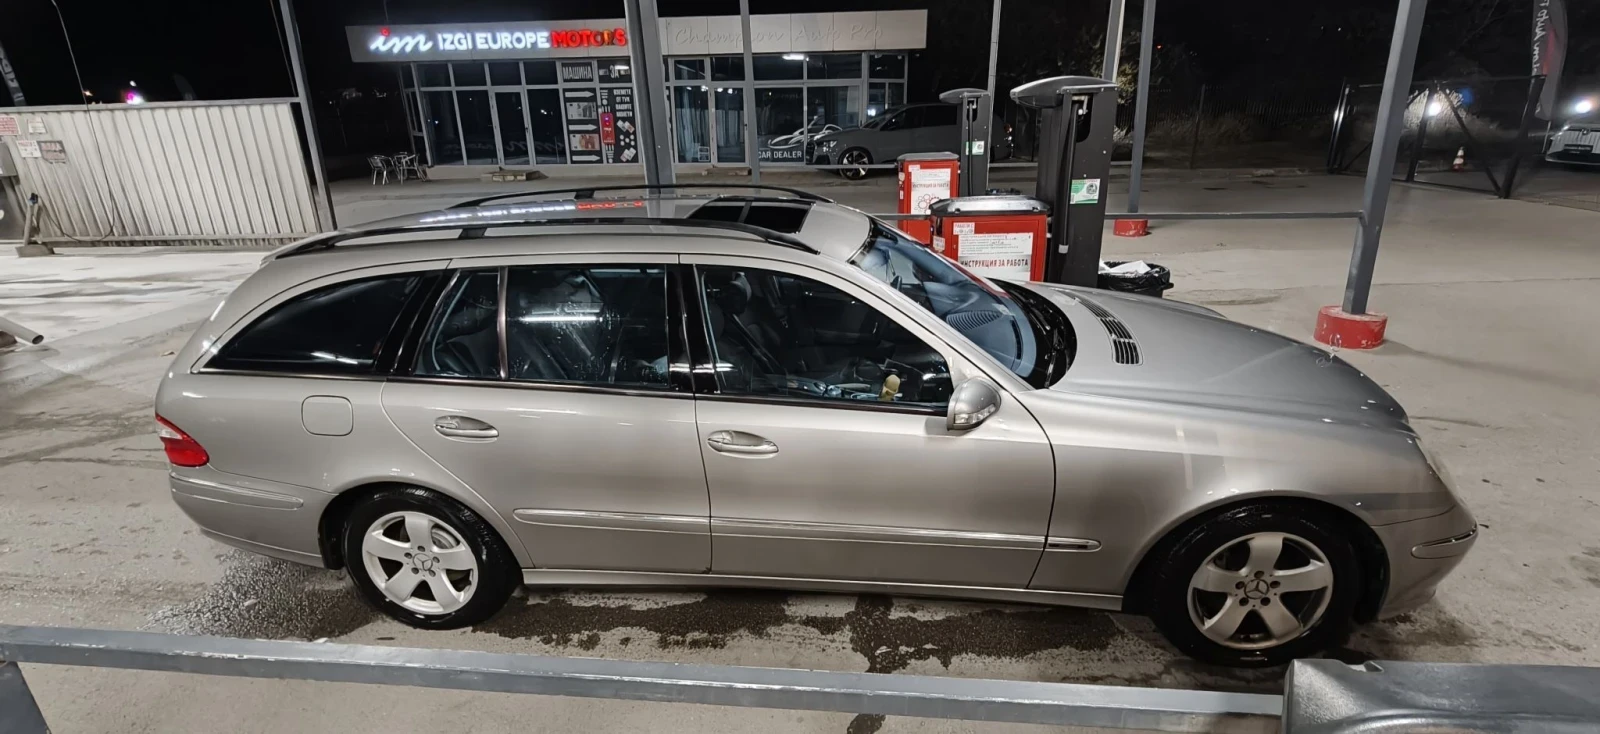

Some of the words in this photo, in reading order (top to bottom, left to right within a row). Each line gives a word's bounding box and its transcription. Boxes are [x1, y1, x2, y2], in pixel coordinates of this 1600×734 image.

[438, 33, 472, 50] IZGI
[476, 31, 549, 48] EUROPE
[551, 28, 627, 47] MOTORS
[675, 28, 784, 48] Champon
[794, 24, 840, 43] Auto
[850, 23, 883, 41] Pro
[562, 66, 592, 79] МАШИНА
[773, 151, 802, 159] DEALER
[998, 259, 1005, 267] ЗА
[1006, 258, 1029, 267] РАБОТА
